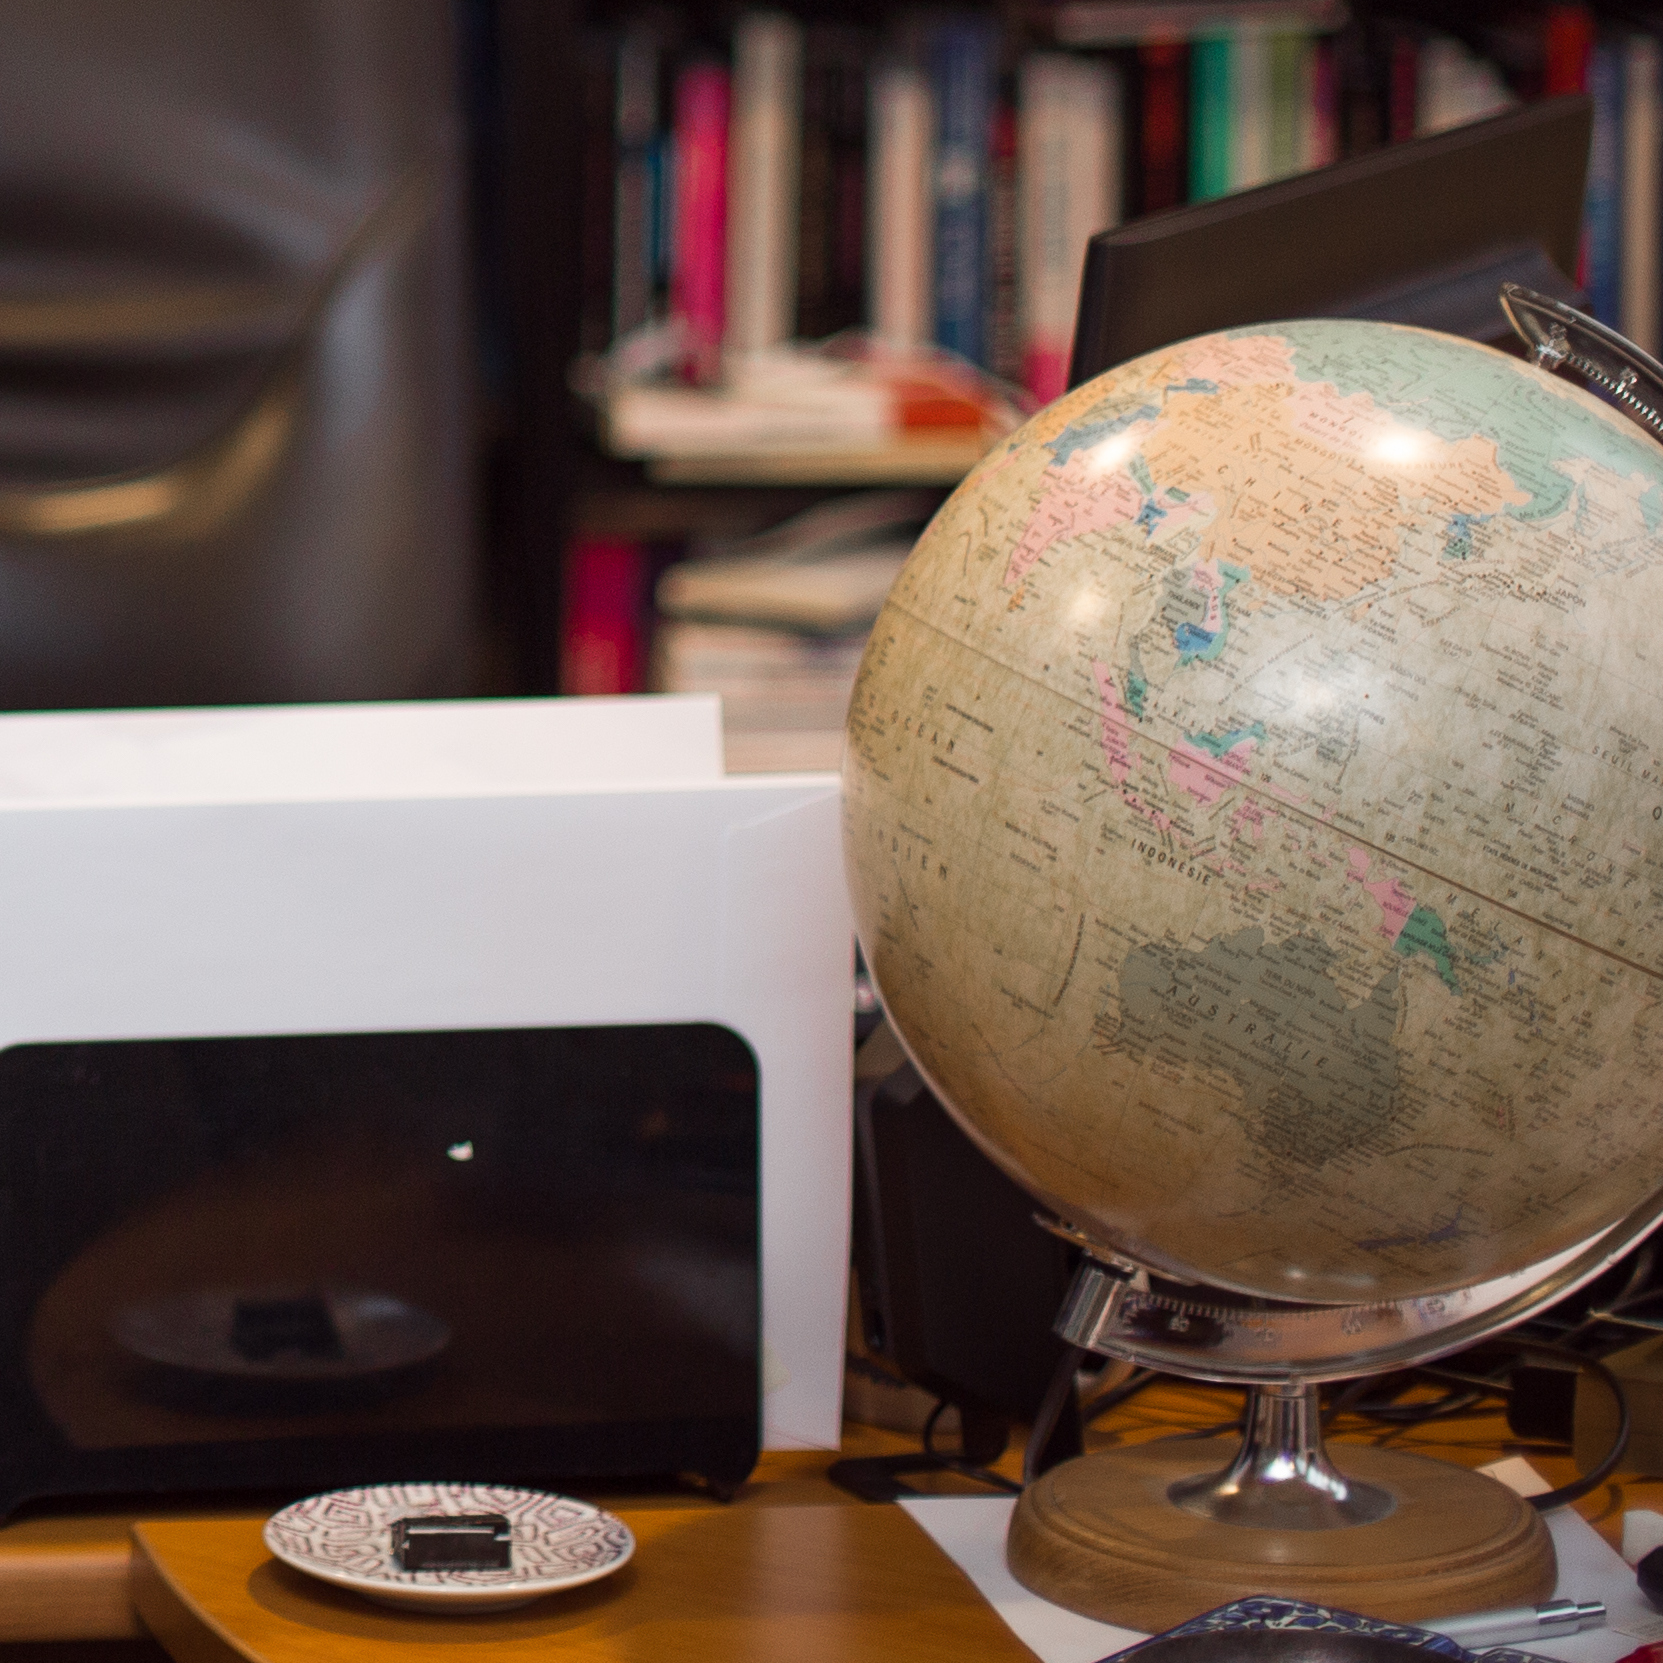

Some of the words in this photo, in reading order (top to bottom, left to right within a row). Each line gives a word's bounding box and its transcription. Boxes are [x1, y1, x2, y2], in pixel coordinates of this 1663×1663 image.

[1217, 464, 1343, 529] CHINE
[1553, 586, 1588, 608] JAPON
[1590, 743, 1635, 773] SEUIL
[1167, 985, 1329, 1068] AUSTRALIE
